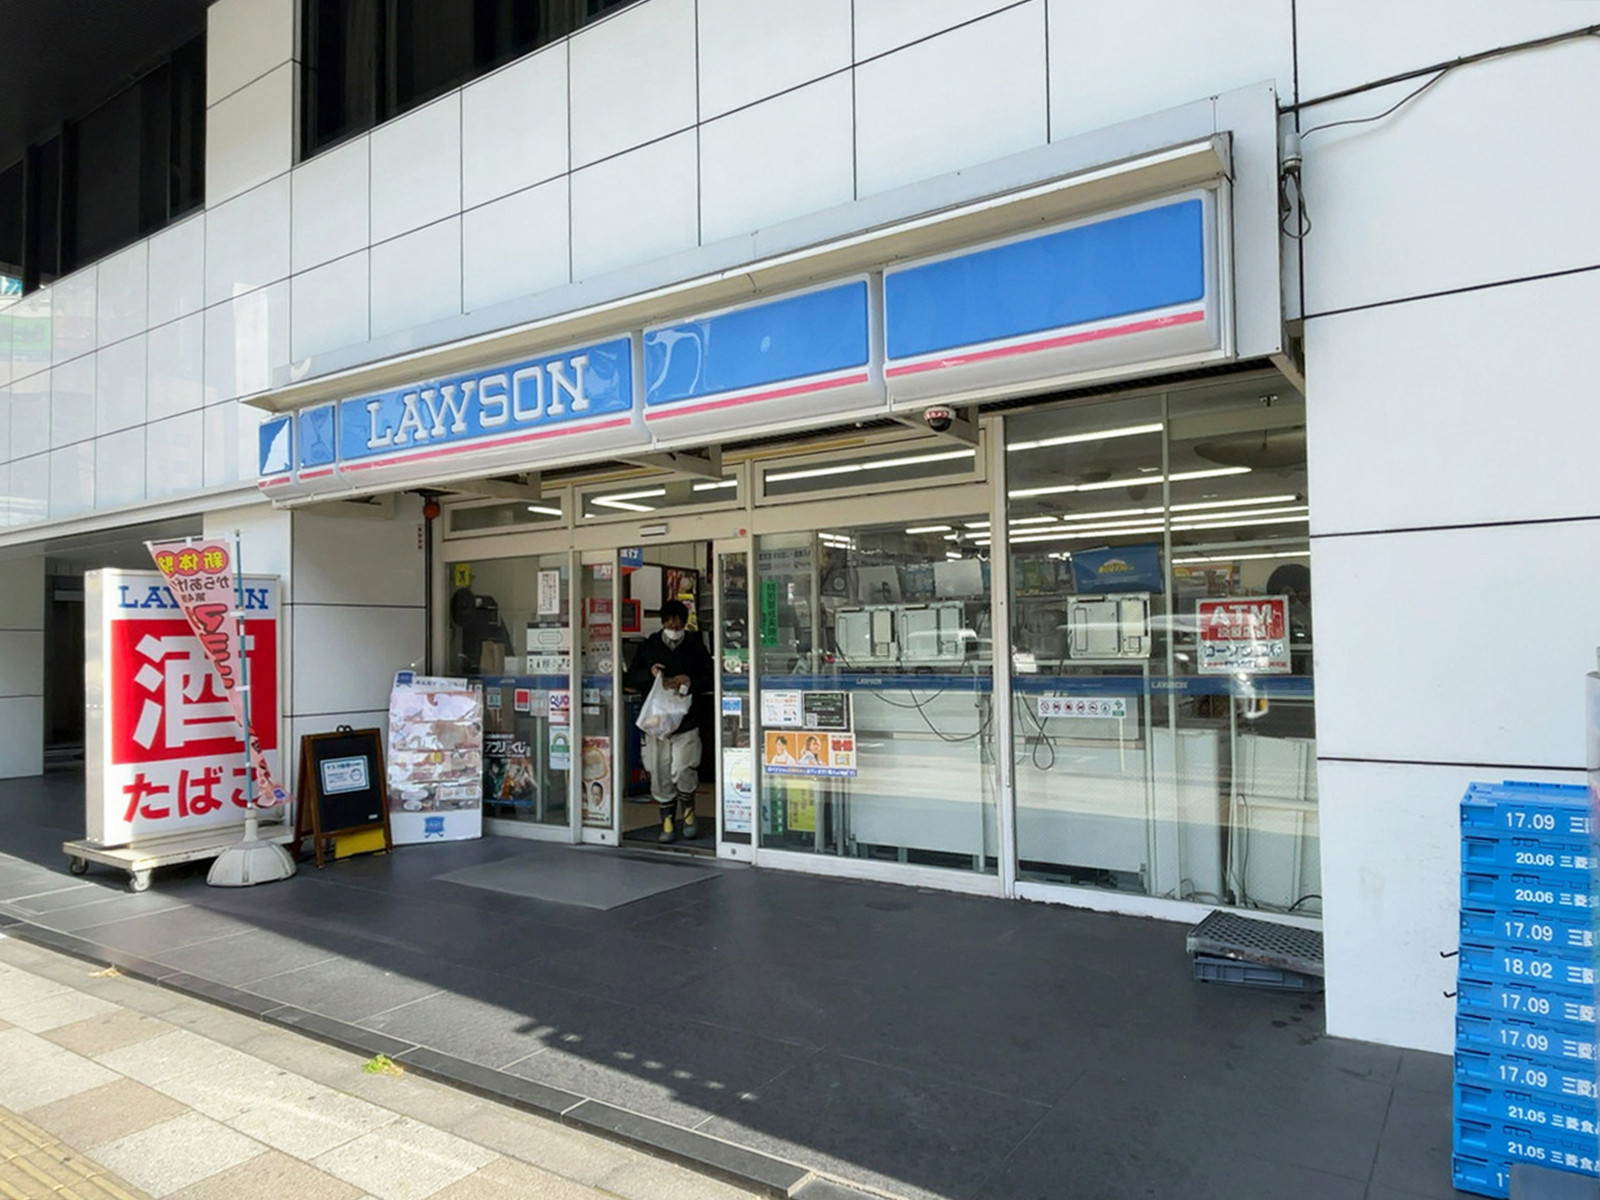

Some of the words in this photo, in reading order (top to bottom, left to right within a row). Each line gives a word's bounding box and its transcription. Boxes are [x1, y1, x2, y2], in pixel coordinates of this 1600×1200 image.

[366, 355, 589, 449] LAWSON
[1210, 603, 1272, 626] ATM
[133, 634, 255, 749] 酒
[122, 766, 258, 823] たばこ
[1506, 812, 1555, 830] 17.09
[1515, 852, 1555, 867] 20.06
[1515, 889, 1554, 904] 20.06
[1505, 922, 1553, 941] 17.09
[1504, 958, 1552, 979] 18.02
[1501, 993, 1550, 1014] 17.09
[1500, 1030, 1549, 1051] 17.09
[1499, 1065, 1548, 1087] 17.09
[1508, 1105, 1546, 1124] 21.05
[1507, 1141, 1545, 1160] 21.05
